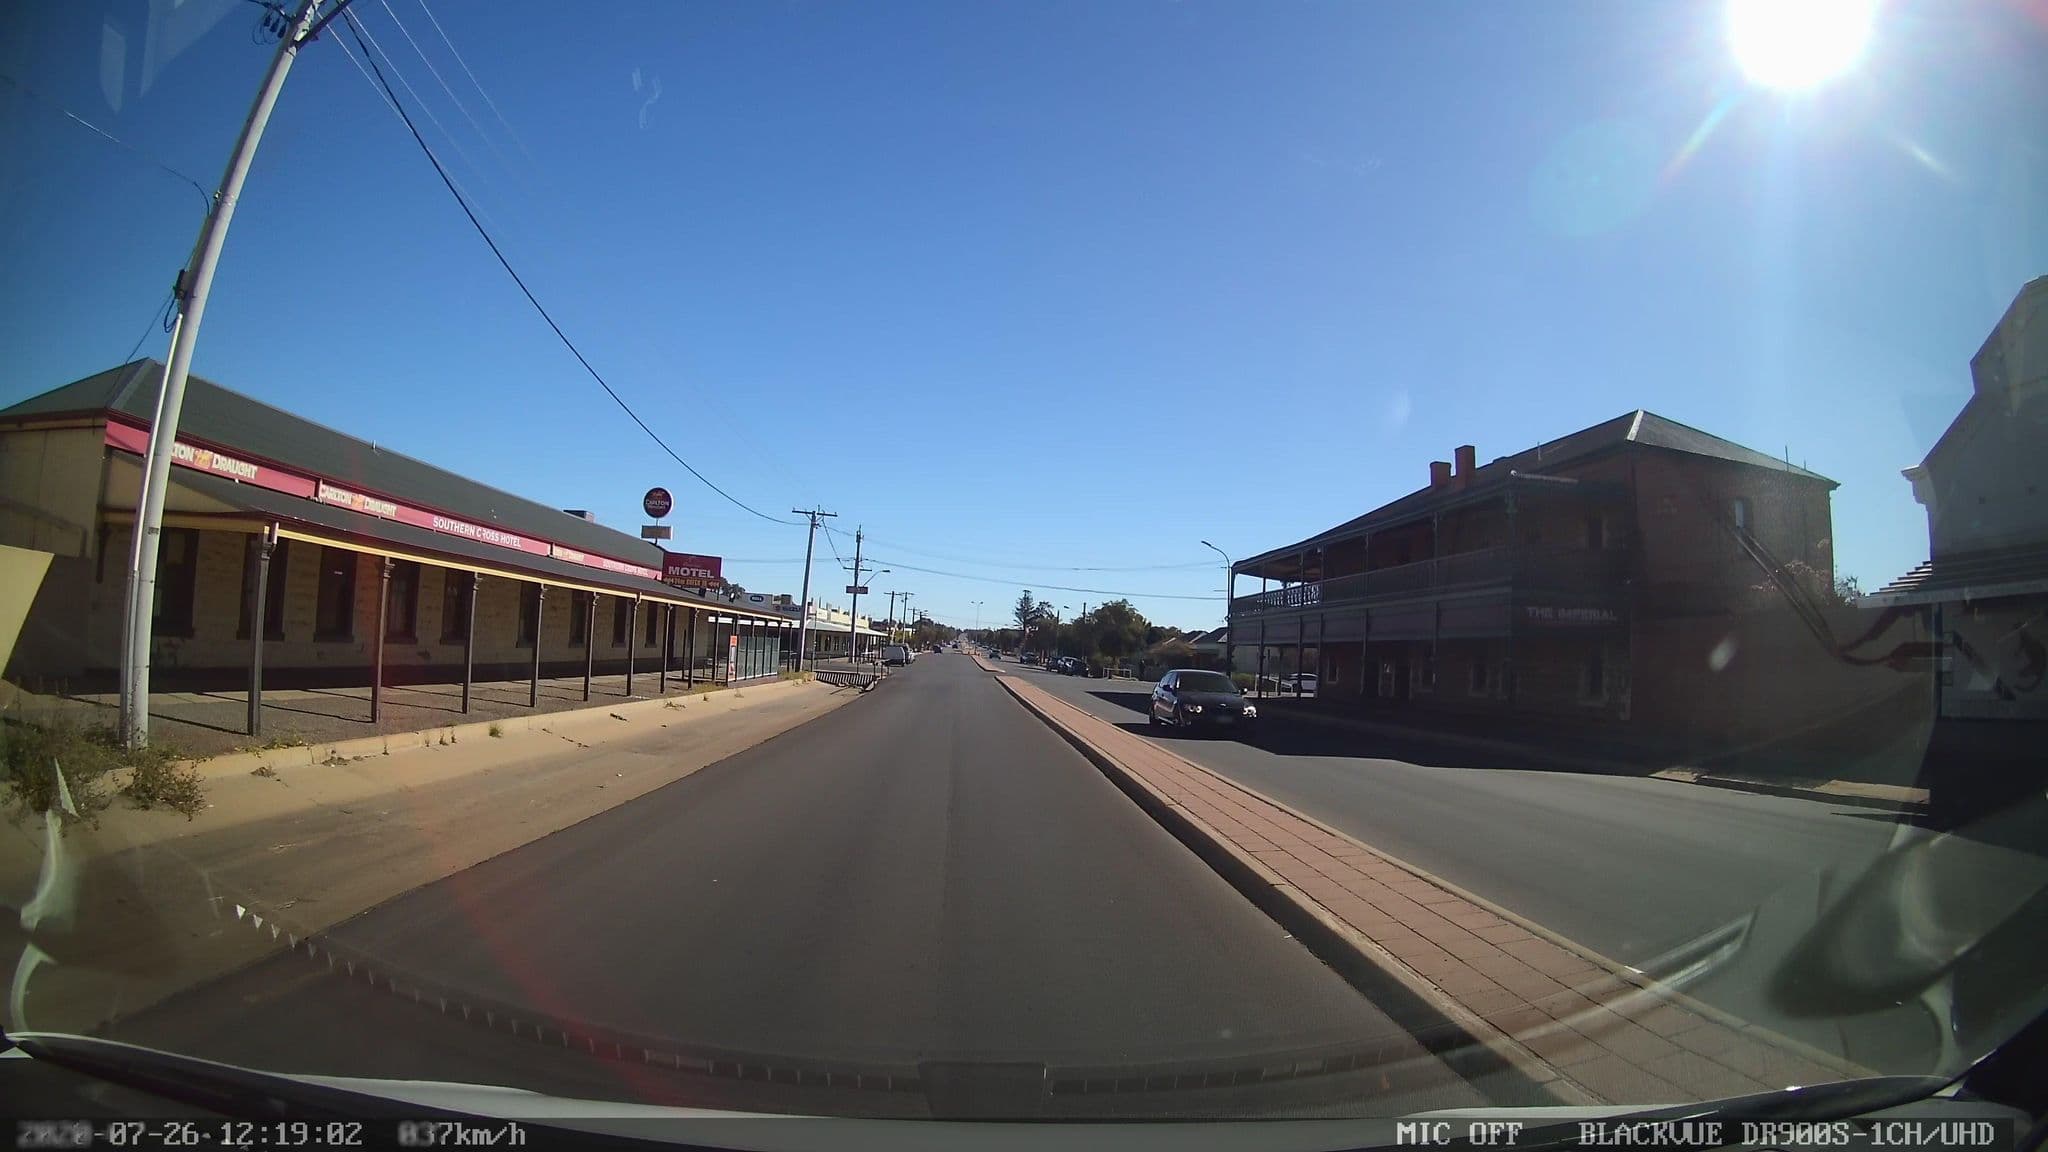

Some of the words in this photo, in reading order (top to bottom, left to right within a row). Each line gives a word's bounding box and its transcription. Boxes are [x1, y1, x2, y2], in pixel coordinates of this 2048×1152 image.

[212, 453, 258, 479] DRAUGHT
[319, 485, 352, 505] CARLTON
[364, 497, 397, 517] DRAUGHT
[433, 516, 475, 537] SOUTHERN
[476, 527, 499, 542] CROSS
[500, 534, 521, 547] HOTEL
[668, 566, 714, 579] MOTEL
